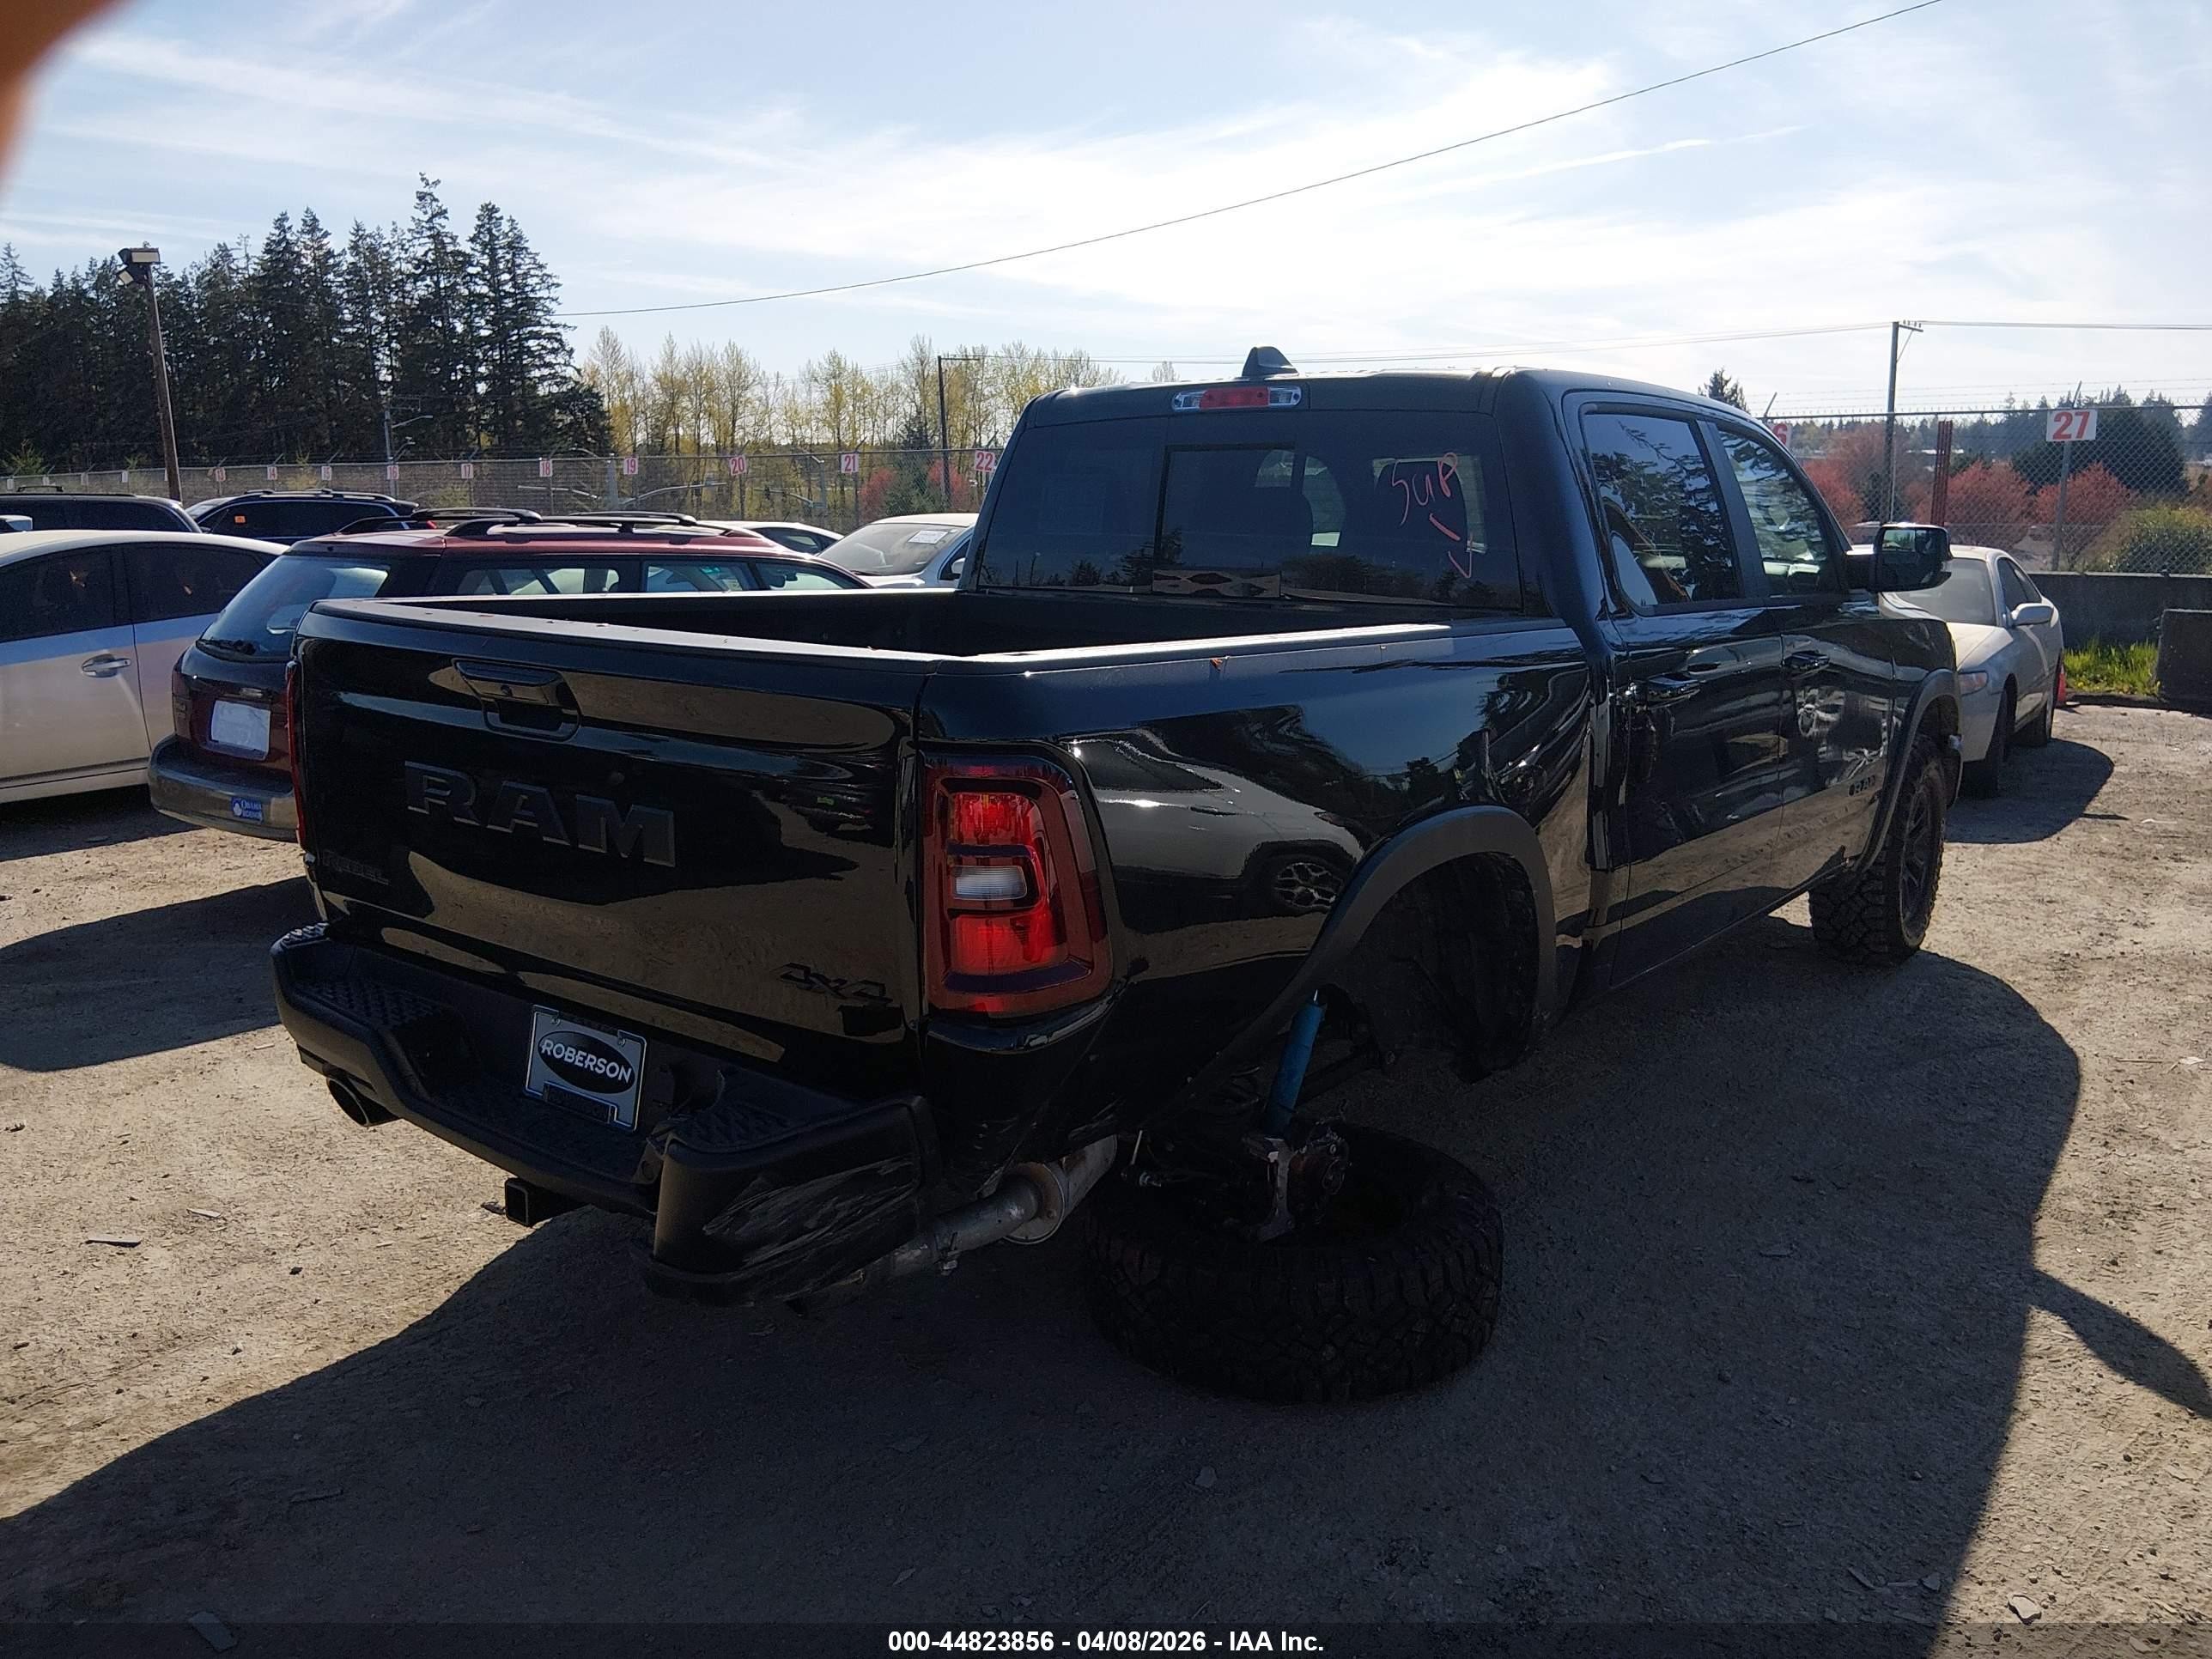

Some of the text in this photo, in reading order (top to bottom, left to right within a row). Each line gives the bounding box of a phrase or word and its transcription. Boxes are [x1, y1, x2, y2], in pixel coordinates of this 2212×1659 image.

[2052, 411, 2089, 440] 27
[541, 462, 550, 475] 18
[626, 459, 637, 473] 19
[731, 457, 745, 473] 20
[844, 455, 856, 471] 21
[975, 452, 994, 471] 22
[463, 465, 471, 477] 17
[404, 760, 676, 867] RAM
[541, 1039, 632, 1084] ROBERSON
